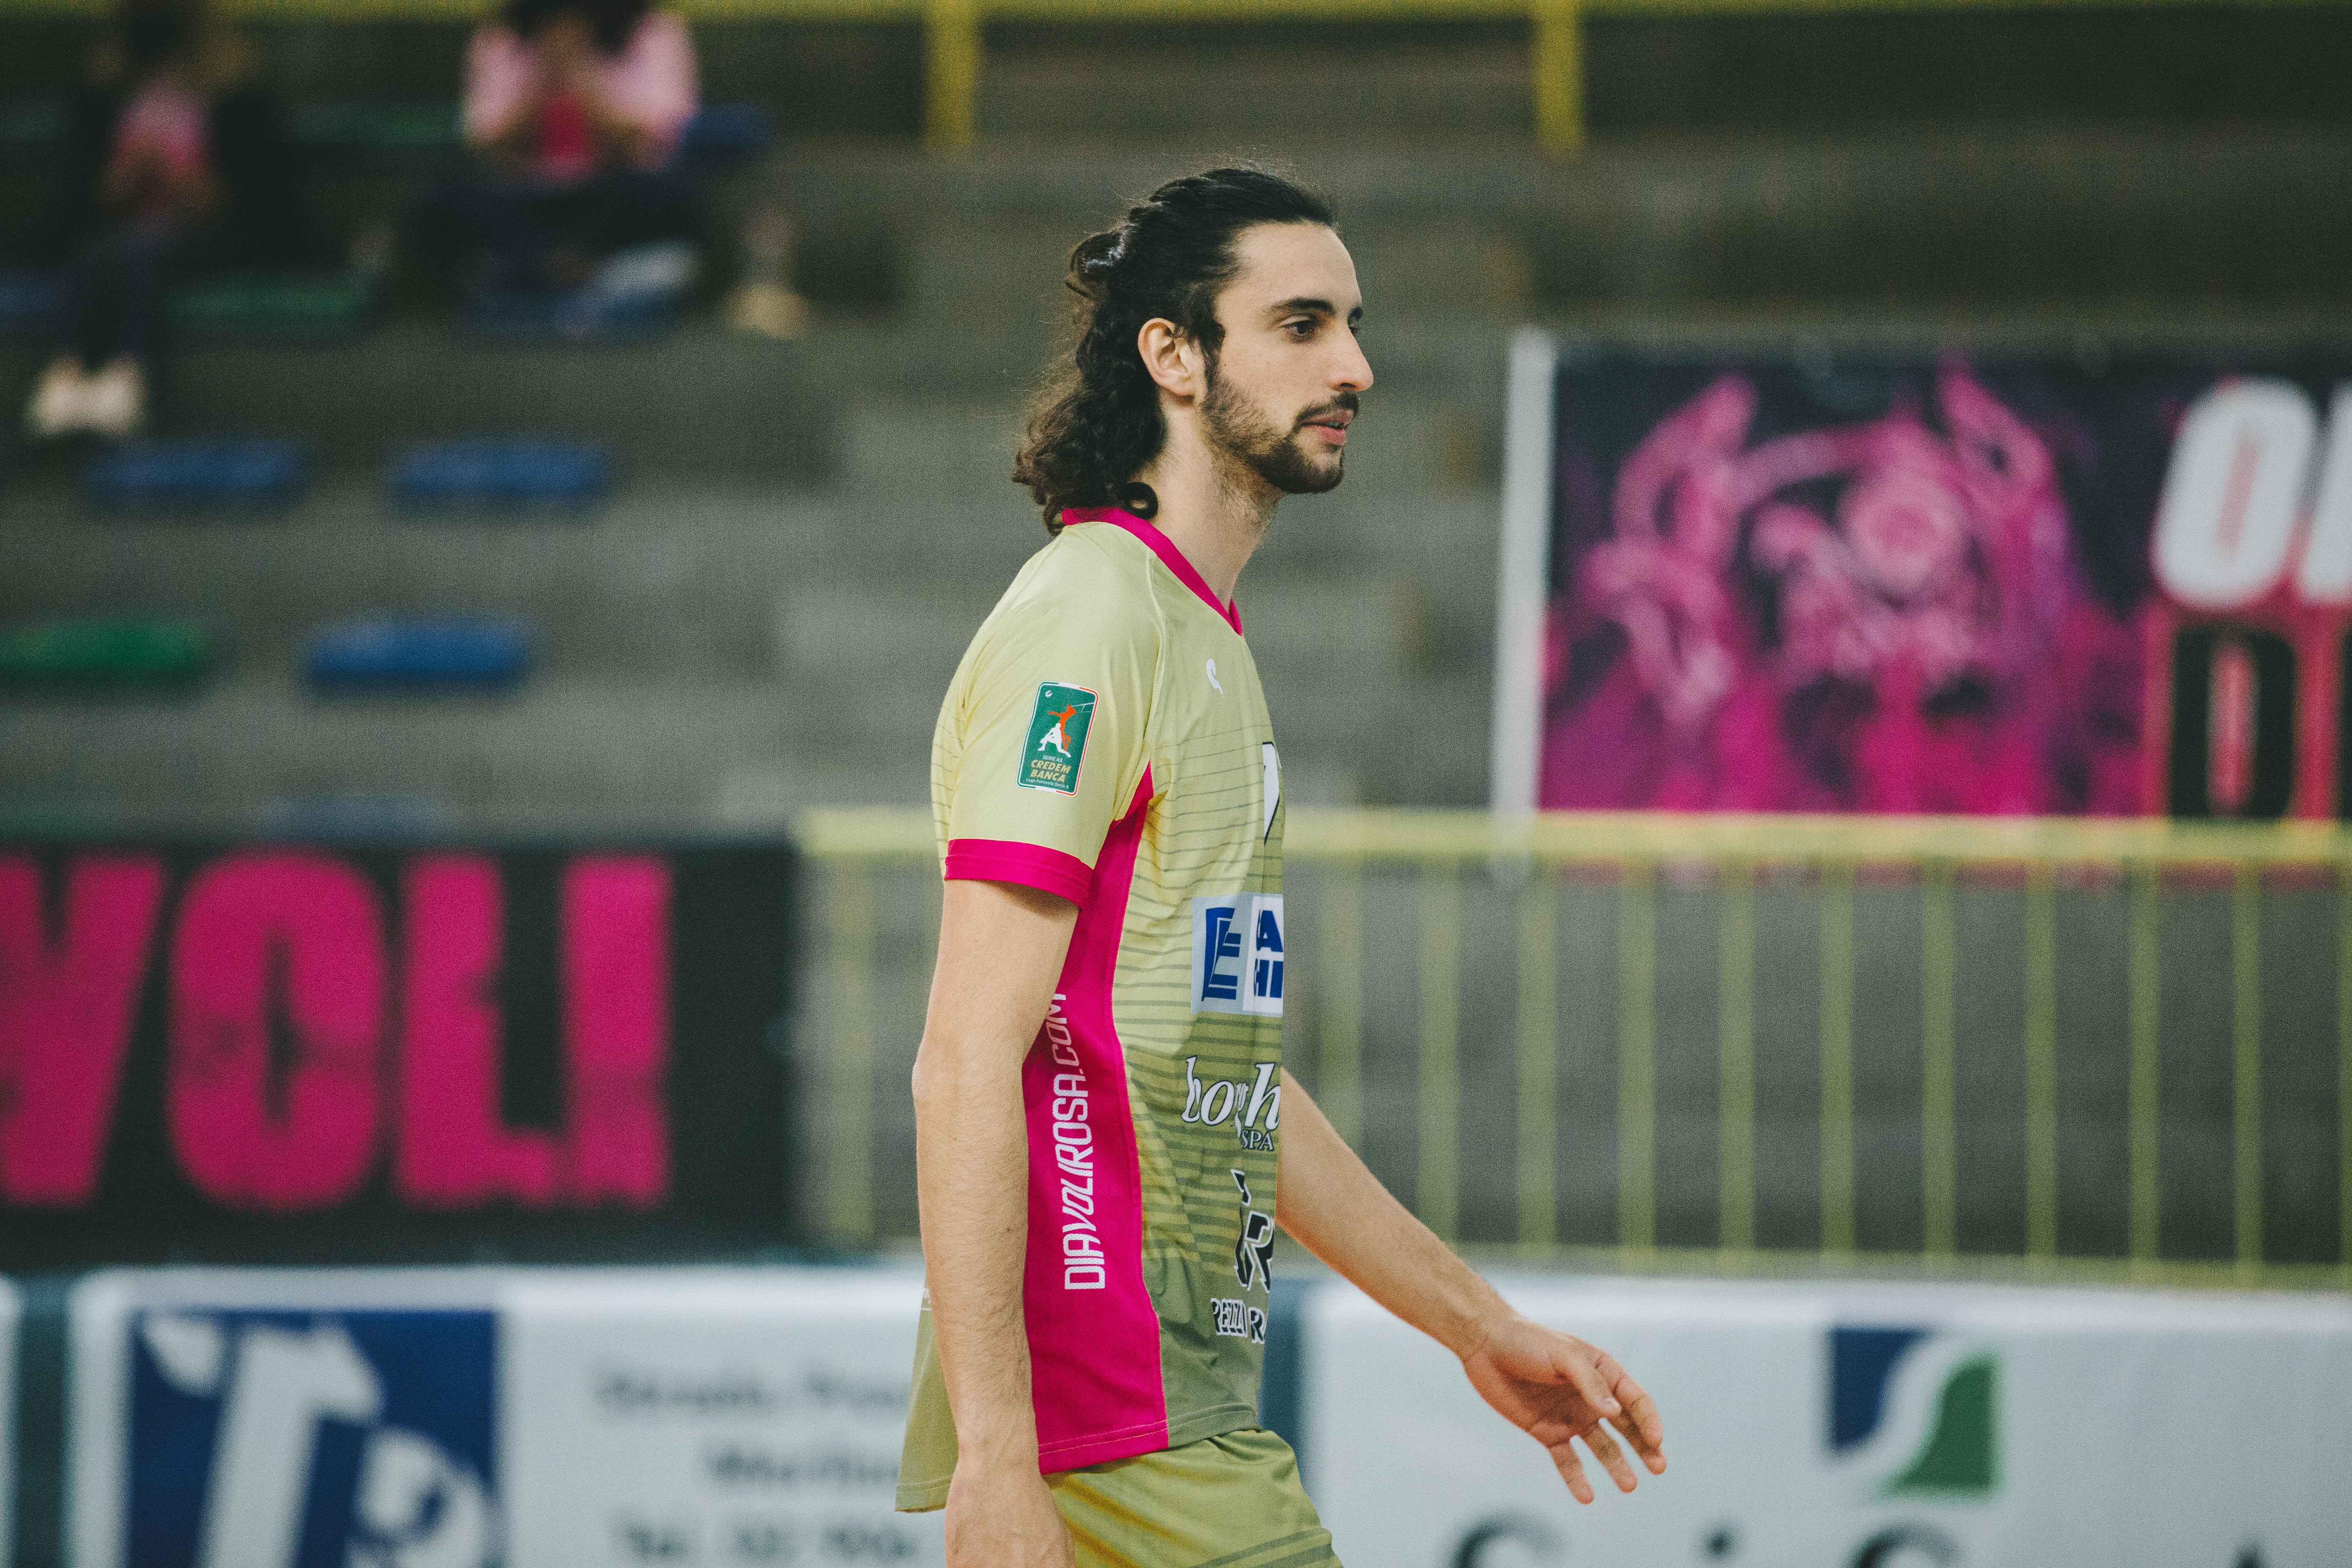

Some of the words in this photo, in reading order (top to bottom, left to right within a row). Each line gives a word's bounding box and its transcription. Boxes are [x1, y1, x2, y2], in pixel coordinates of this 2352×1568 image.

[2150, 376, 2352, 609] O
[1030, 769, 1066, 783] BANCA
[1031, 760, 1071, 774] CREDEM
[0, 849, 670, 1209] VOLI
